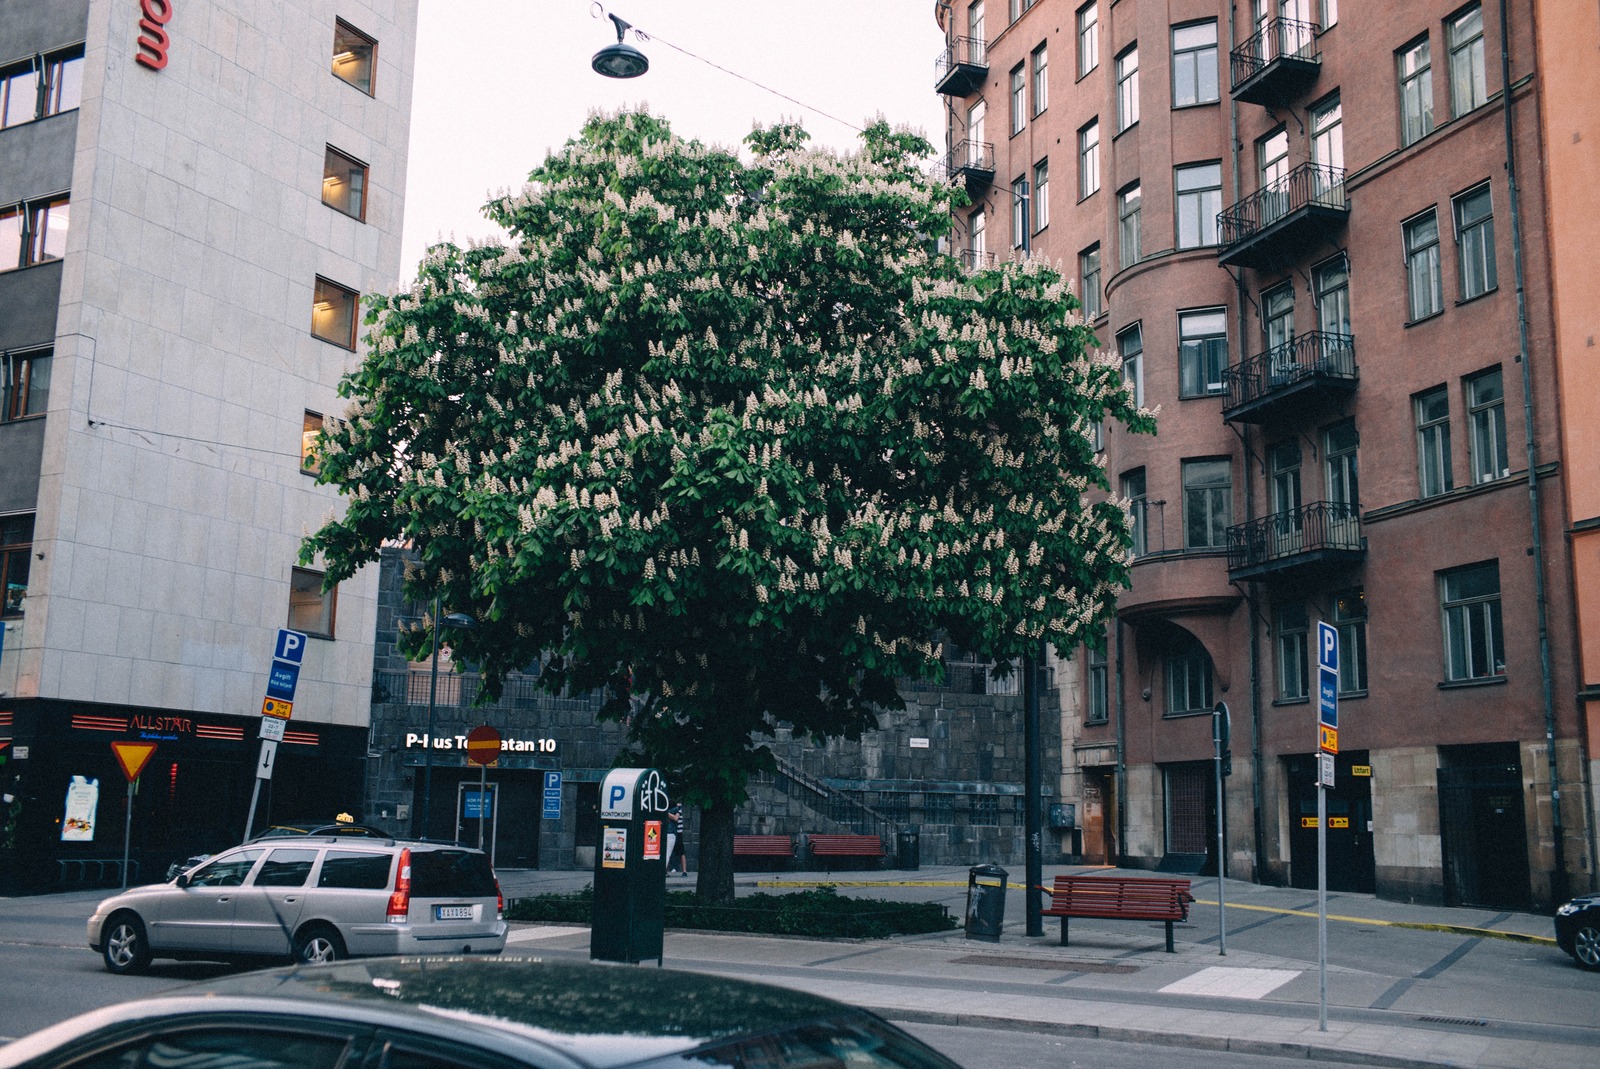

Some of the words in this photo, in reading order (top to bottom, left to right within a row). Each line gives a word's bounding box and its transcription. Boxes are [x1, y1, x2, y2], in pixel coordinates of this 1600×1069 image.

[282, 633, 300, 657] P
[1324, 629, 1335, 663] P
[130, 714, 191, 732] ALLSTAR
[538, 738, 556, 752] 10
[548, 774, 559, 787] P
[609, 785, 625, 809] P
